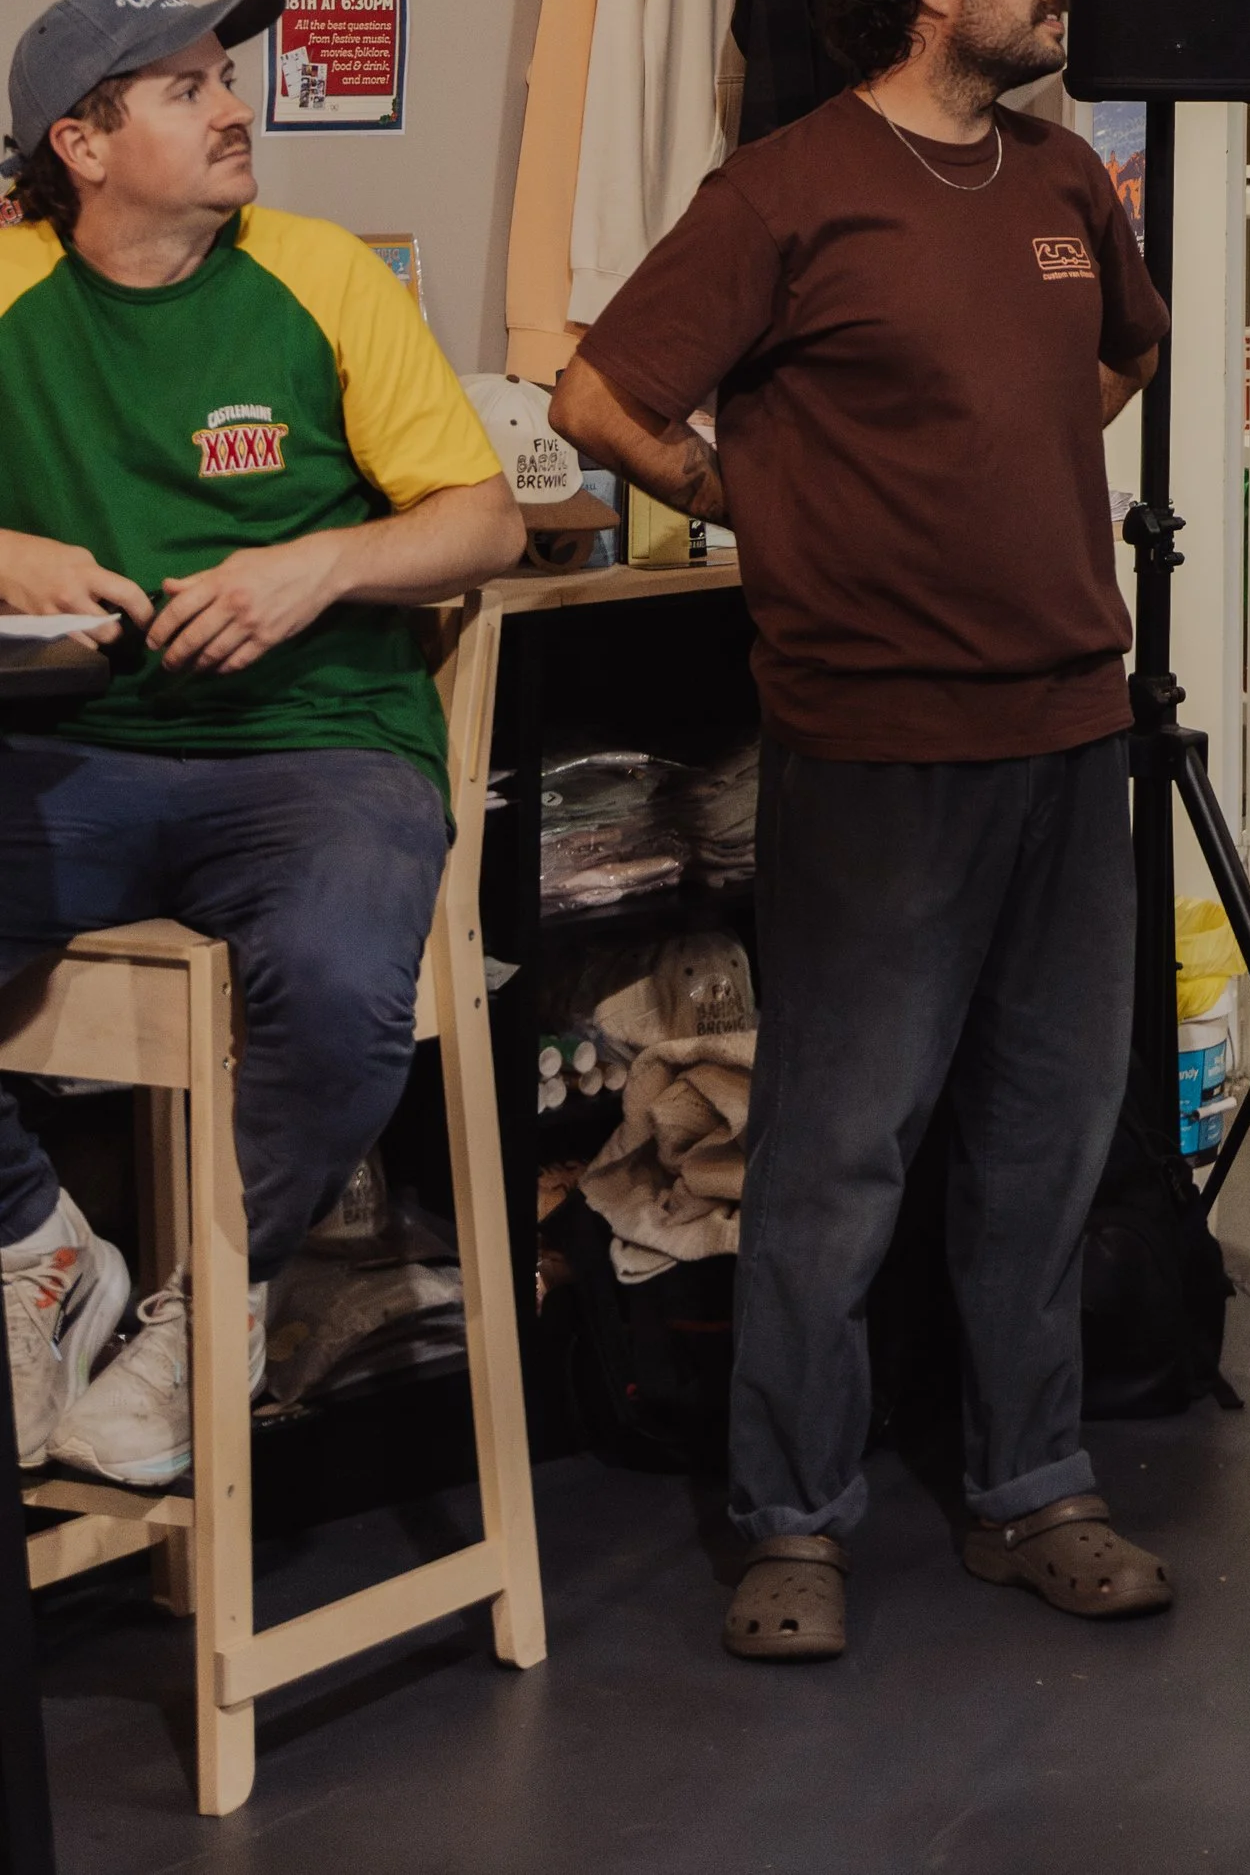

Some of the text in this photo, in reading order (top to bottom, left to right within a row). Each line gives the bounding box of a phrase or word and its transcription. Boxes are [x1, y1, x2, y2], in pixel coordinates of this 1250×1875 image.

[295, 19, 393, 33] All the best questions
[308, 33, 392, 46] from festive music,
[320, 48, 354, 58] movies,
[331, 61, 391, 73] food & drink,
[342, 74, 390, 85] and more!
[203, 427, 283, 474] XXXX
[533, 438, 560, 453] FIVE
